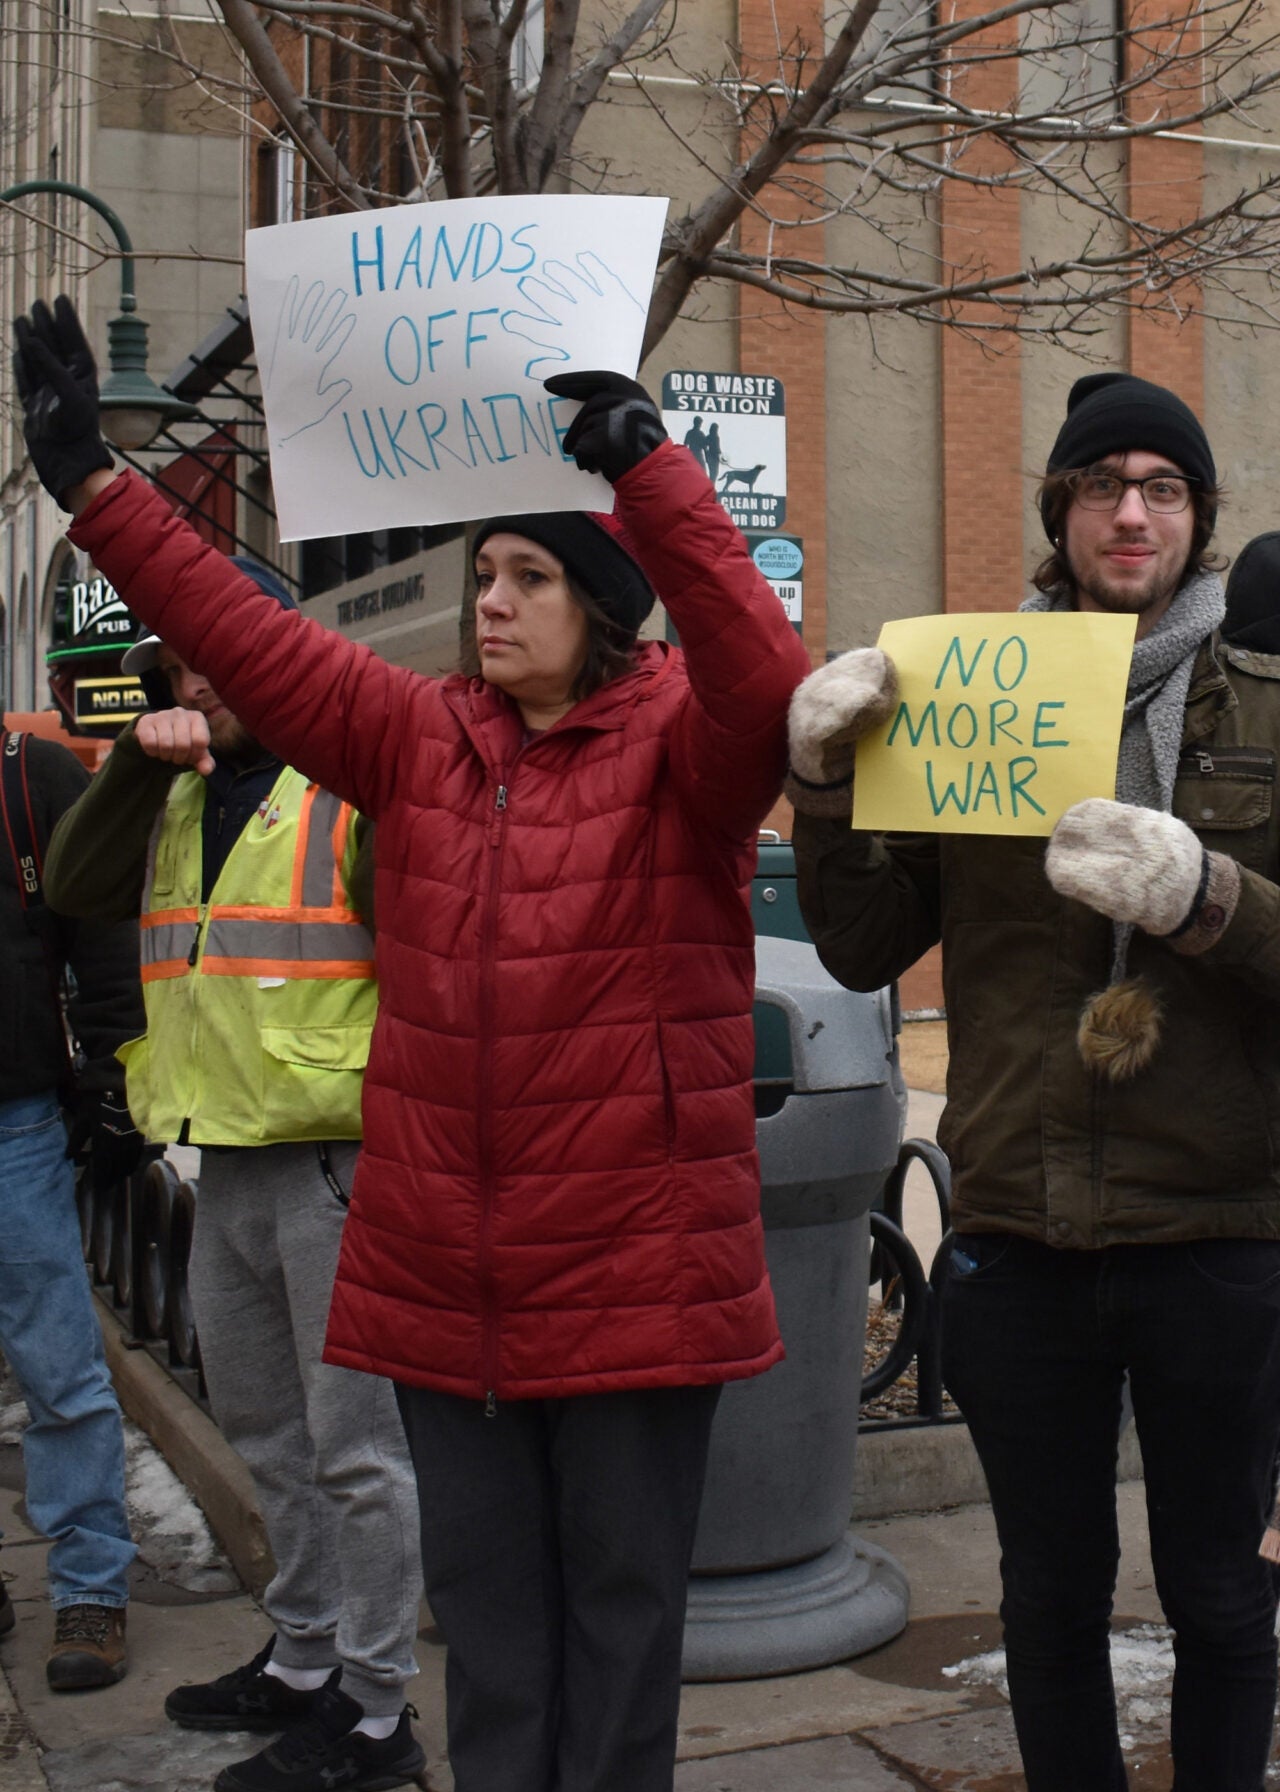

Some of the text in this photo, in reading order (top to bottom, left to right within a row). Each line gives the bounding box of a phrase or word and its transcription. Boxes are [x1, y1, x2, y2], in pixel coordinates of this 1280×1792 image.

[352, 222, 539, 297] HANDS
[384, 307, 499, 386] OFF
[671, 373, 776, 396] DOG WASTE
[678, 395, 770, 414] STATION
[343, 393, 578, 480] UKRAINE
[721, 497, 778, 511] CLEAN UP
[732, 514, 777, 527] UR DOG
[780, 587, 796, 600] up
[97, 619, 131, 634] PUB
[935, 635, 1028, 691] NO
[92, 690, 121, 709] NO
[886, 699, 1070, 748] MORE
[926, 756, 1046, 817] WAR
[20, 855, 38, 893] EOS
